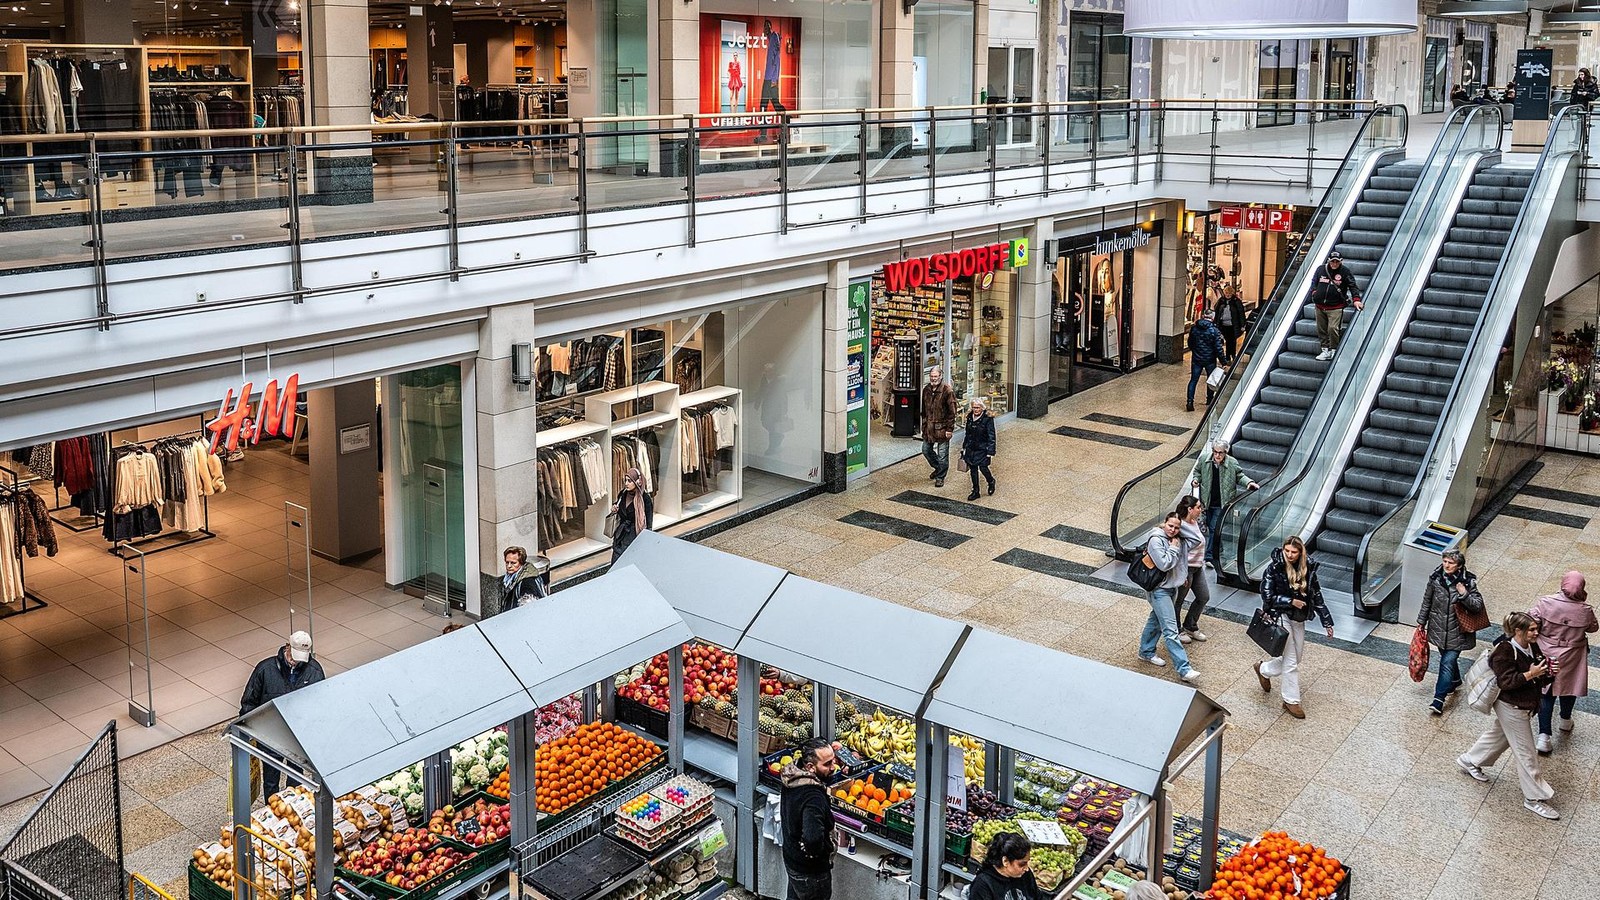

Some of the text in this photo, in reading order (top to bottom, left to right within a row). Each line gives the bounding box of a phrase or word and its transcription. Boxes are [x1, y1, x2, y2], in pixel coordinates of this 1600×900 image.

[728, 30, 767, 49] Jetzt
[1270, 211, 1282, 225] P
[1095, 228, 1151, 256] hunkemöller
[883, 242, 1010, 292] WOLSDORFF
[852, 318, 861, 329] EIN
[205, 372, 299, 456] H&M
